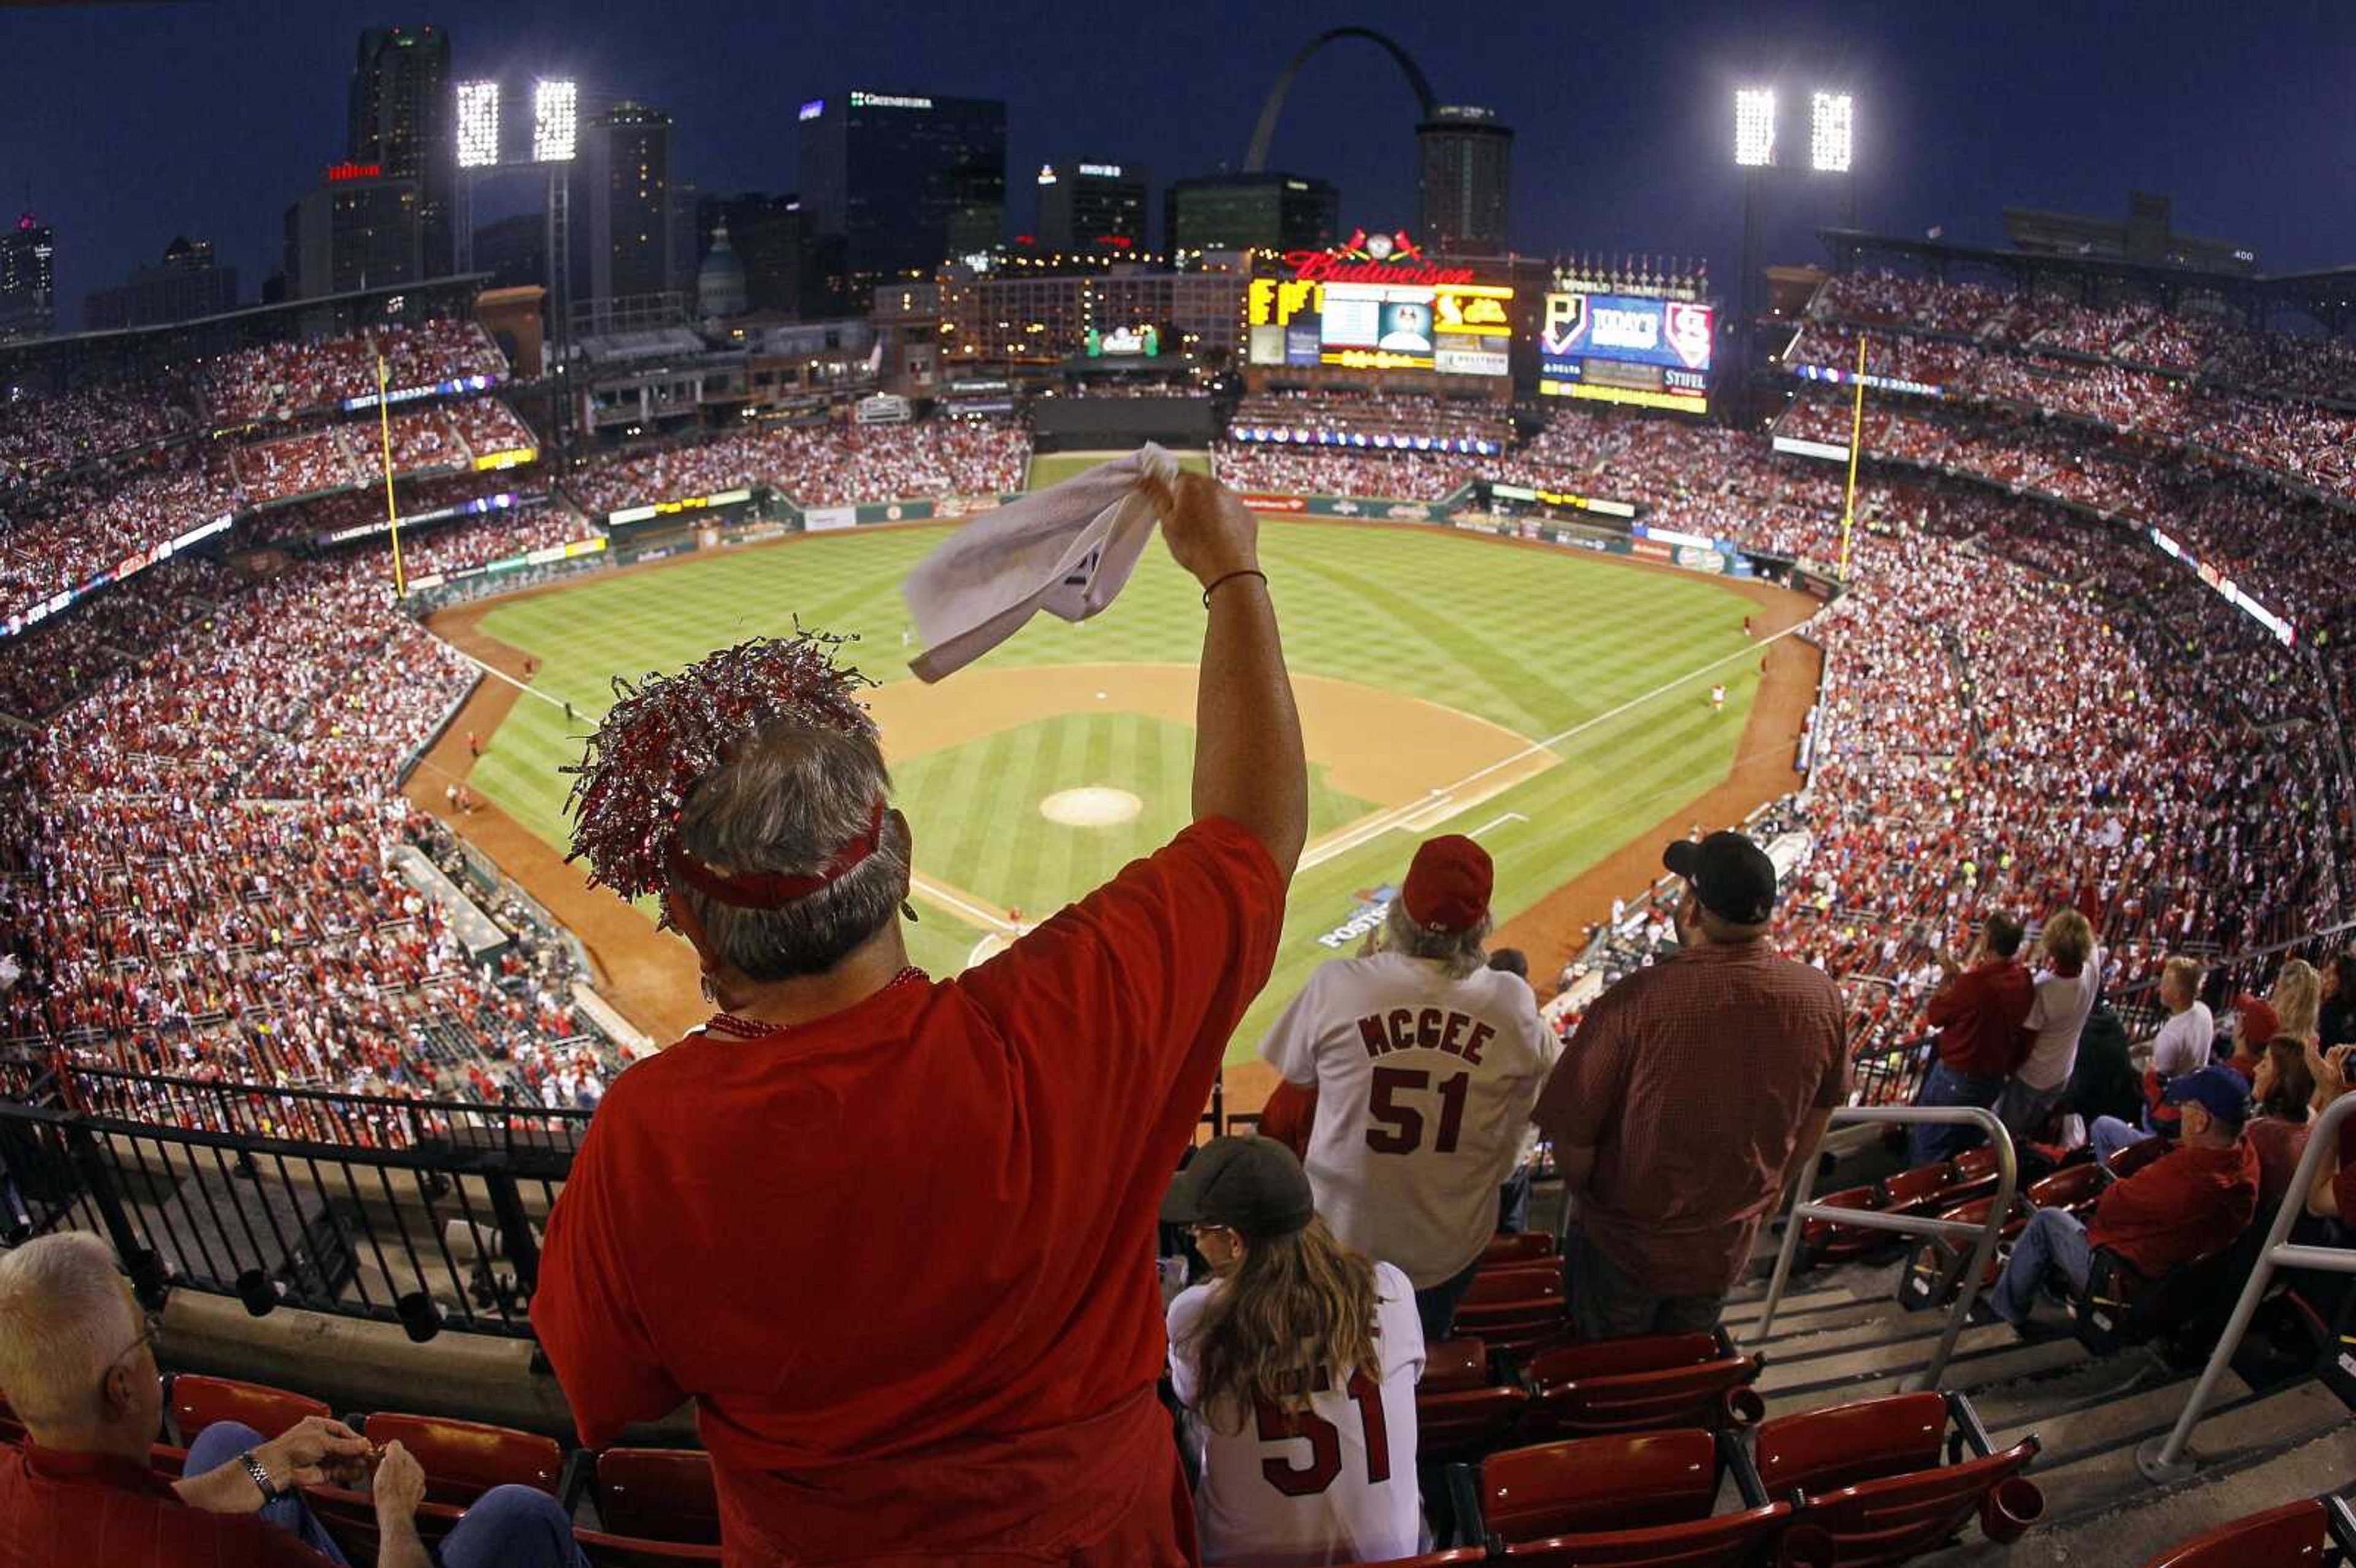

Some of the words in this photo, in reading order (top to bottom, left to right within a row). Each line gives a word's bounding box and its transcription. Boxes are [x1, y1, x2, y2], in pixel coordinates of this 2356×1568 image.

[1285, 250, 1472, 284] Budweiser
[1562, 279, 1611, 294] WORLD
[1665, 370, 1706, 389] STIFEL
[1356, 1008, 1496, 1066] MCGEE
[1366, 1066, 1469, 1155] 51
[1254, 1366, 1390, 1497] 51
